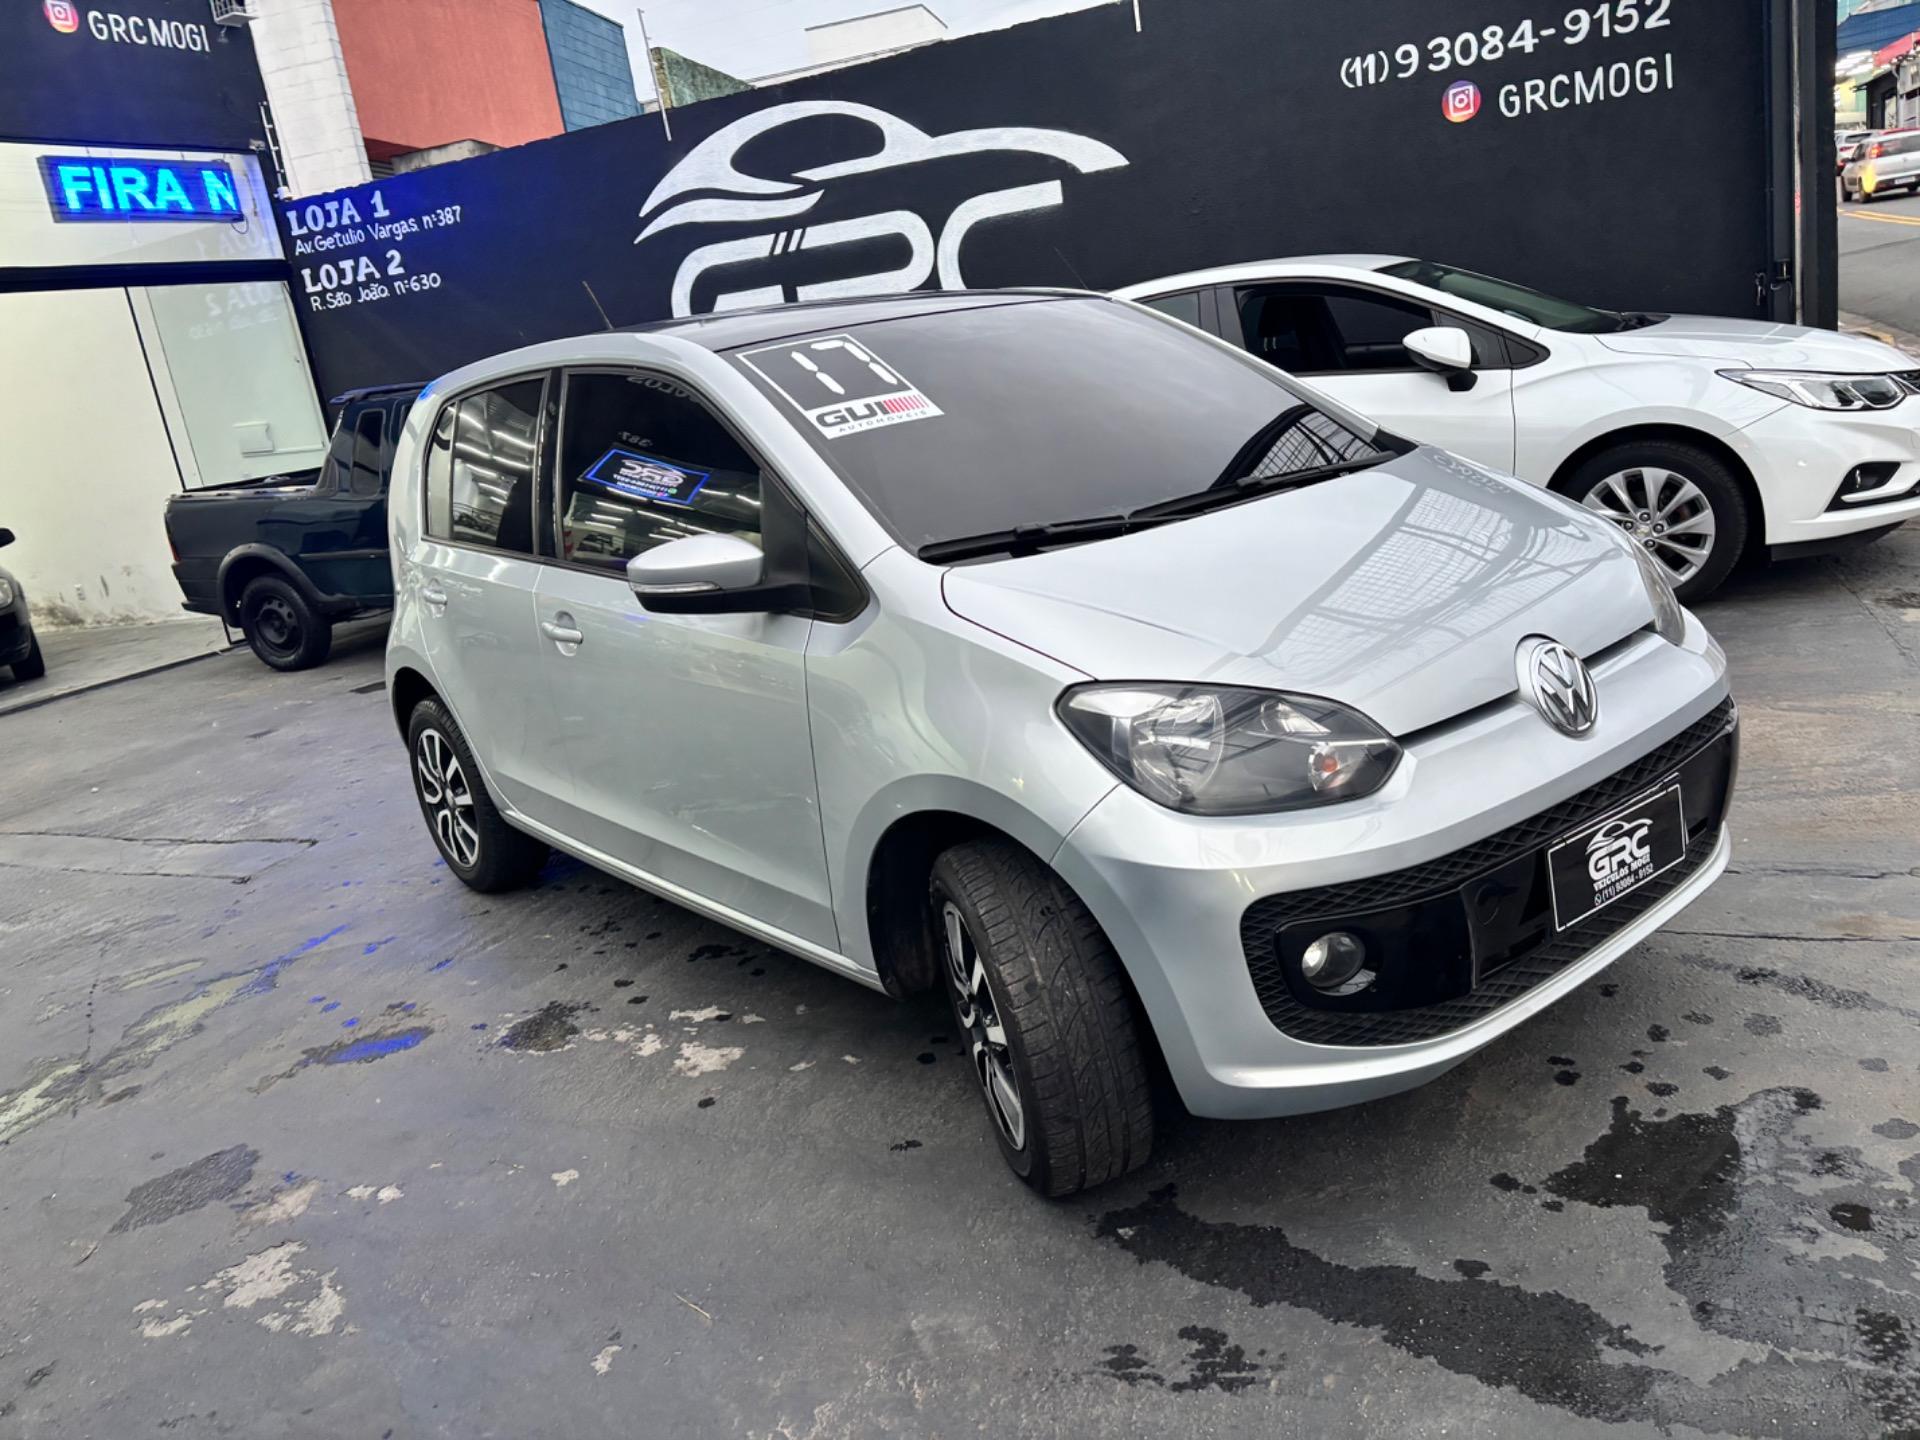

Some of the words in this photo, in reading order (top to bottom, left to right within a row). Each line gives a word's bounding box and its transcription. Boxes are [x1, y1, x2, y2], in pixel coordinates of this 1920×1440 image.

[87, 10, 210, 52] GRCMOGI
[1499, 53, 1674, 118] GRCMOGI
[58, 165, 194, 211] FIRA
[286, 197, 361, 236] LOJA
[370, 190, 390, 218] 1
[301, 256, 381, 293] LOJA
[385, 249, 405, 276] 2
[791, 339, 898, 395] 17
[815, 401, 891, 428] GUI
[1588, 825, 1651, 880] GRC
